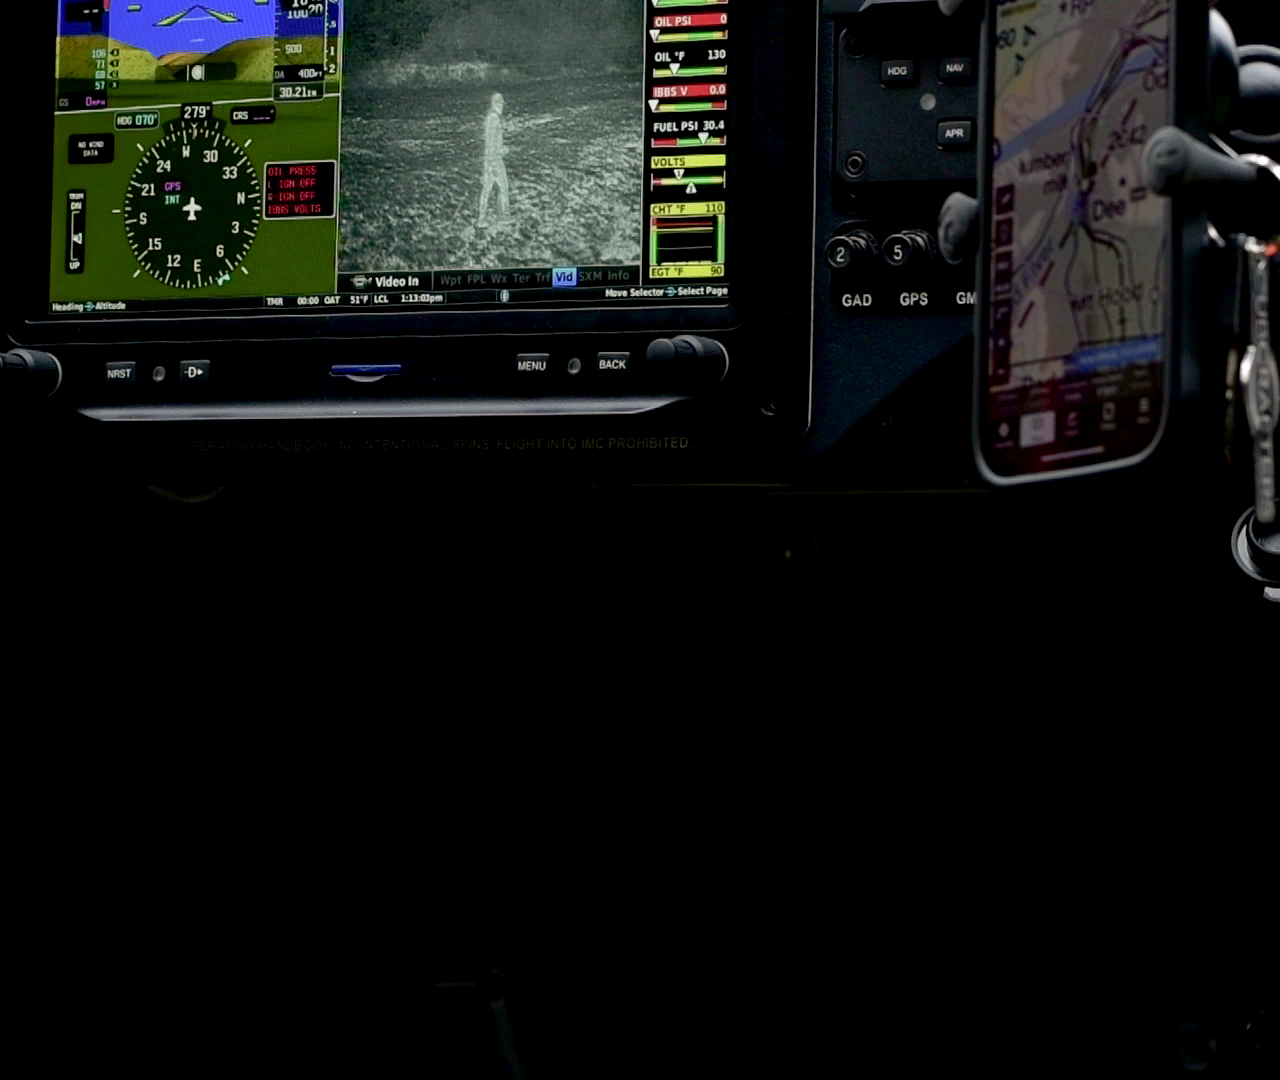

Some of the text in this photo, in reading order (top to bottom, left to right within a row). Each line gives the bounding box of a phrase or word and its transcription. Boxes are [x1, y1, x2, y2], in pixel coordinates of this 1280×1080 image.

[655, 16, 691, 27] OIL PSI
[654, 49, 726, 62] OIL 130
[887, 66, 907, 76] HDG
[946, 63, 965, 72] NAV
[653, 84, 726, 97] IBBS 0.0
[183, 105, 211, 119] 279°
[653, 120, 725, 132] FUEL PSI 30.4
[945, 128, 964, 138] APR
[202, 149, 219, 163] 30
[653, 156, 685, 167] VOLTS
[156, 160, 172, 173] 24
[289, 165, 317, 176] PRESS
[222, 166, 238, 180] 33
[141, 183, 156, 196] 21
[294, 203, 321, 214] VOLTS
[652, 202, 724, 215] CHT 110
[148, 238, 162, 251] 15
[167, 254, 181, 267] 12
[555, 271, 573, 282] Vid
[651, 266, 673, 277] EGT
[375, 275, 406, 288] Video
[605, 287, 665, 298] Move Selector
[677, 286, 729, 298] Select Page
[842, 293, 872, 307] GAD
[900, 292, 928, 306] GPS
[52, 301, 83, 312] Heading
[95, 300, 126, 311] Altitude
[517, 361, 547, 372] MENU
[599, 359, 627, 370] BACK
[107, 368, 132, 379] NRST
[496, 438, 542, 450] FLIGHT
[547, 438, 577, 450] INTO
[581, 437, 604, 449] IMC
[608, 436, 692, 449] PROHIBITED.
